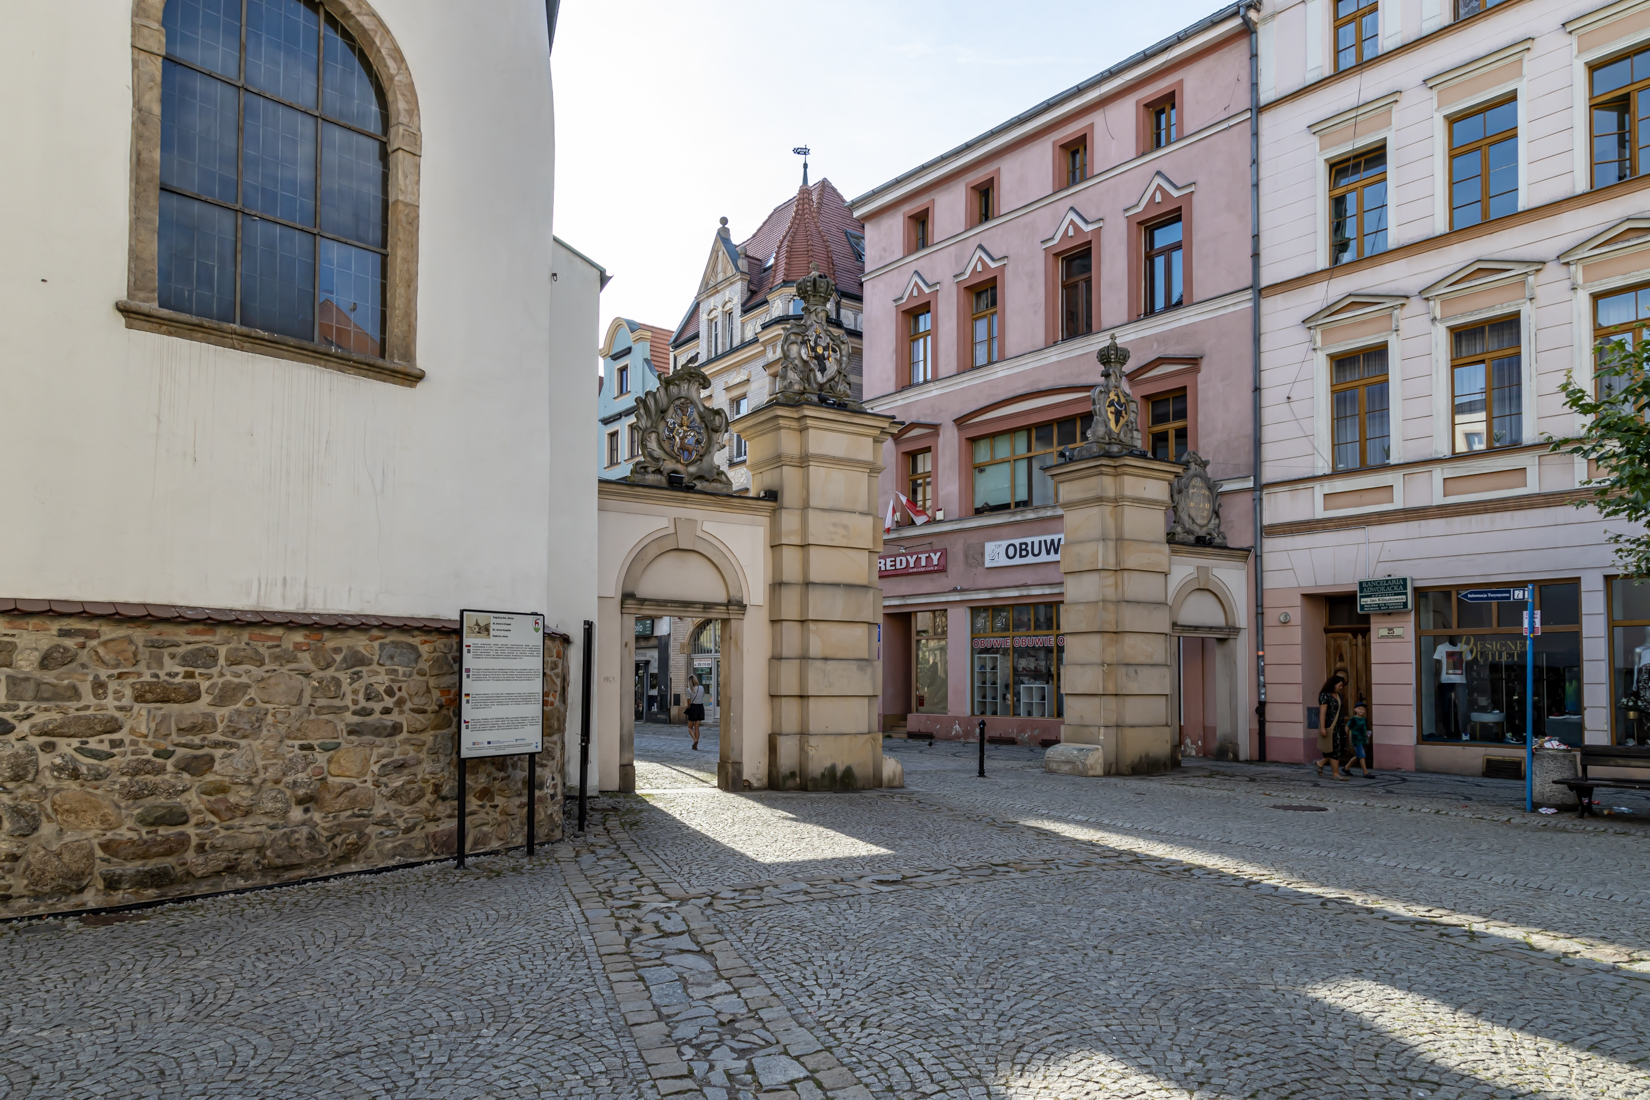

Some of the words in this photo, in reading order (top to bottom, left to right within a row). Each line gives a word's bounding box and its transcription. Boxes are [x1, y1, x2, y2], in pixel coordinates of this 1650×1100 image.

[1005, 538, 1062, 560] OBUW
[878, 552, 942, 571] REDYTY
[1362, 579, 1404, 587] KANCELARIA
[1362, 585, 1404, 593] ADWOKACKA
[972, 638, 1010, 648] OBUWIE
[1013, 636, 1054, 647] OBUWIE
[1058, 636, 1065, 646] O
[1460, 636, 1528, 652] DESIGNE
[1462, 646, 1520, 662] OUTLET
